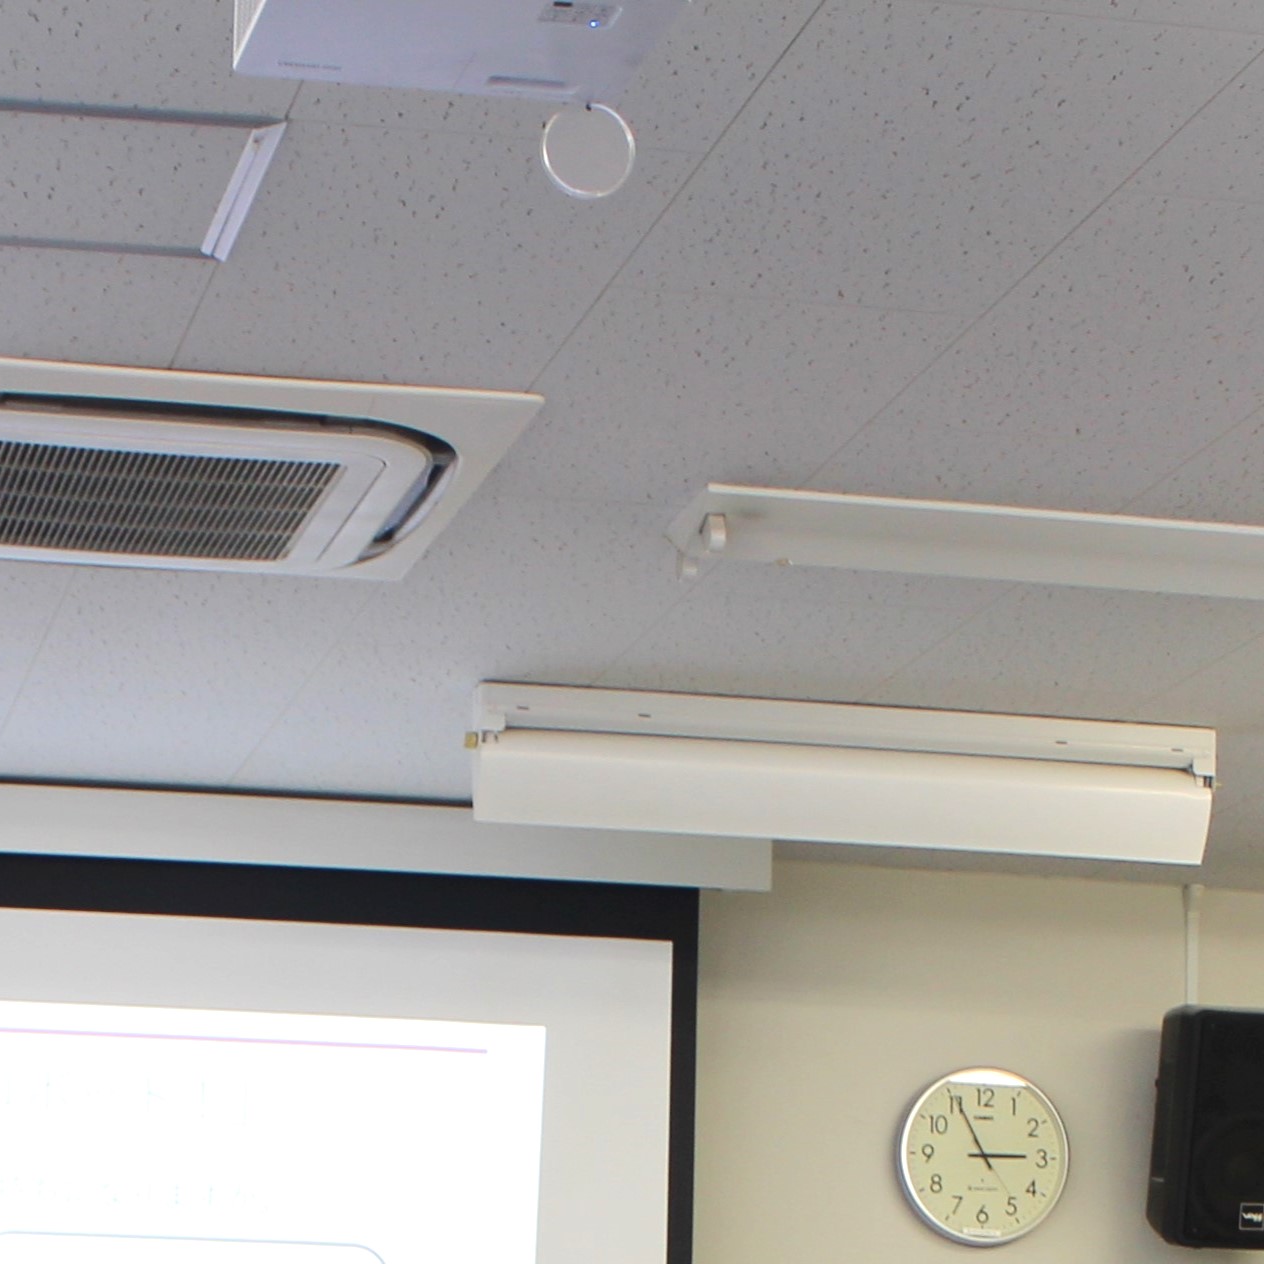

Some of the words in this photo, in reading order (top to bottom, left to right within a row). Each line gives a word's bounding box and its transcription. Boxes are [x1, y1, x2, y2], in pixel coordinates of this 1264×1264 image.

[977, 1088, 994, 1107] 12
[930, 1115, 948, 1134] 10
[1027, 1118, 1039, 1137] 2
[921, 1144, 934, 1163] 9
[1035, 1149, 1048, 1168] 3
[930, 1174, 943, 1193] 8
[1026, 1180, 1037, 1198] 4
[952, 1195, 963, 1215] 7
[976, 1204, 989, 1224] 6
[1005, 1197, 1017, 1216] 5
